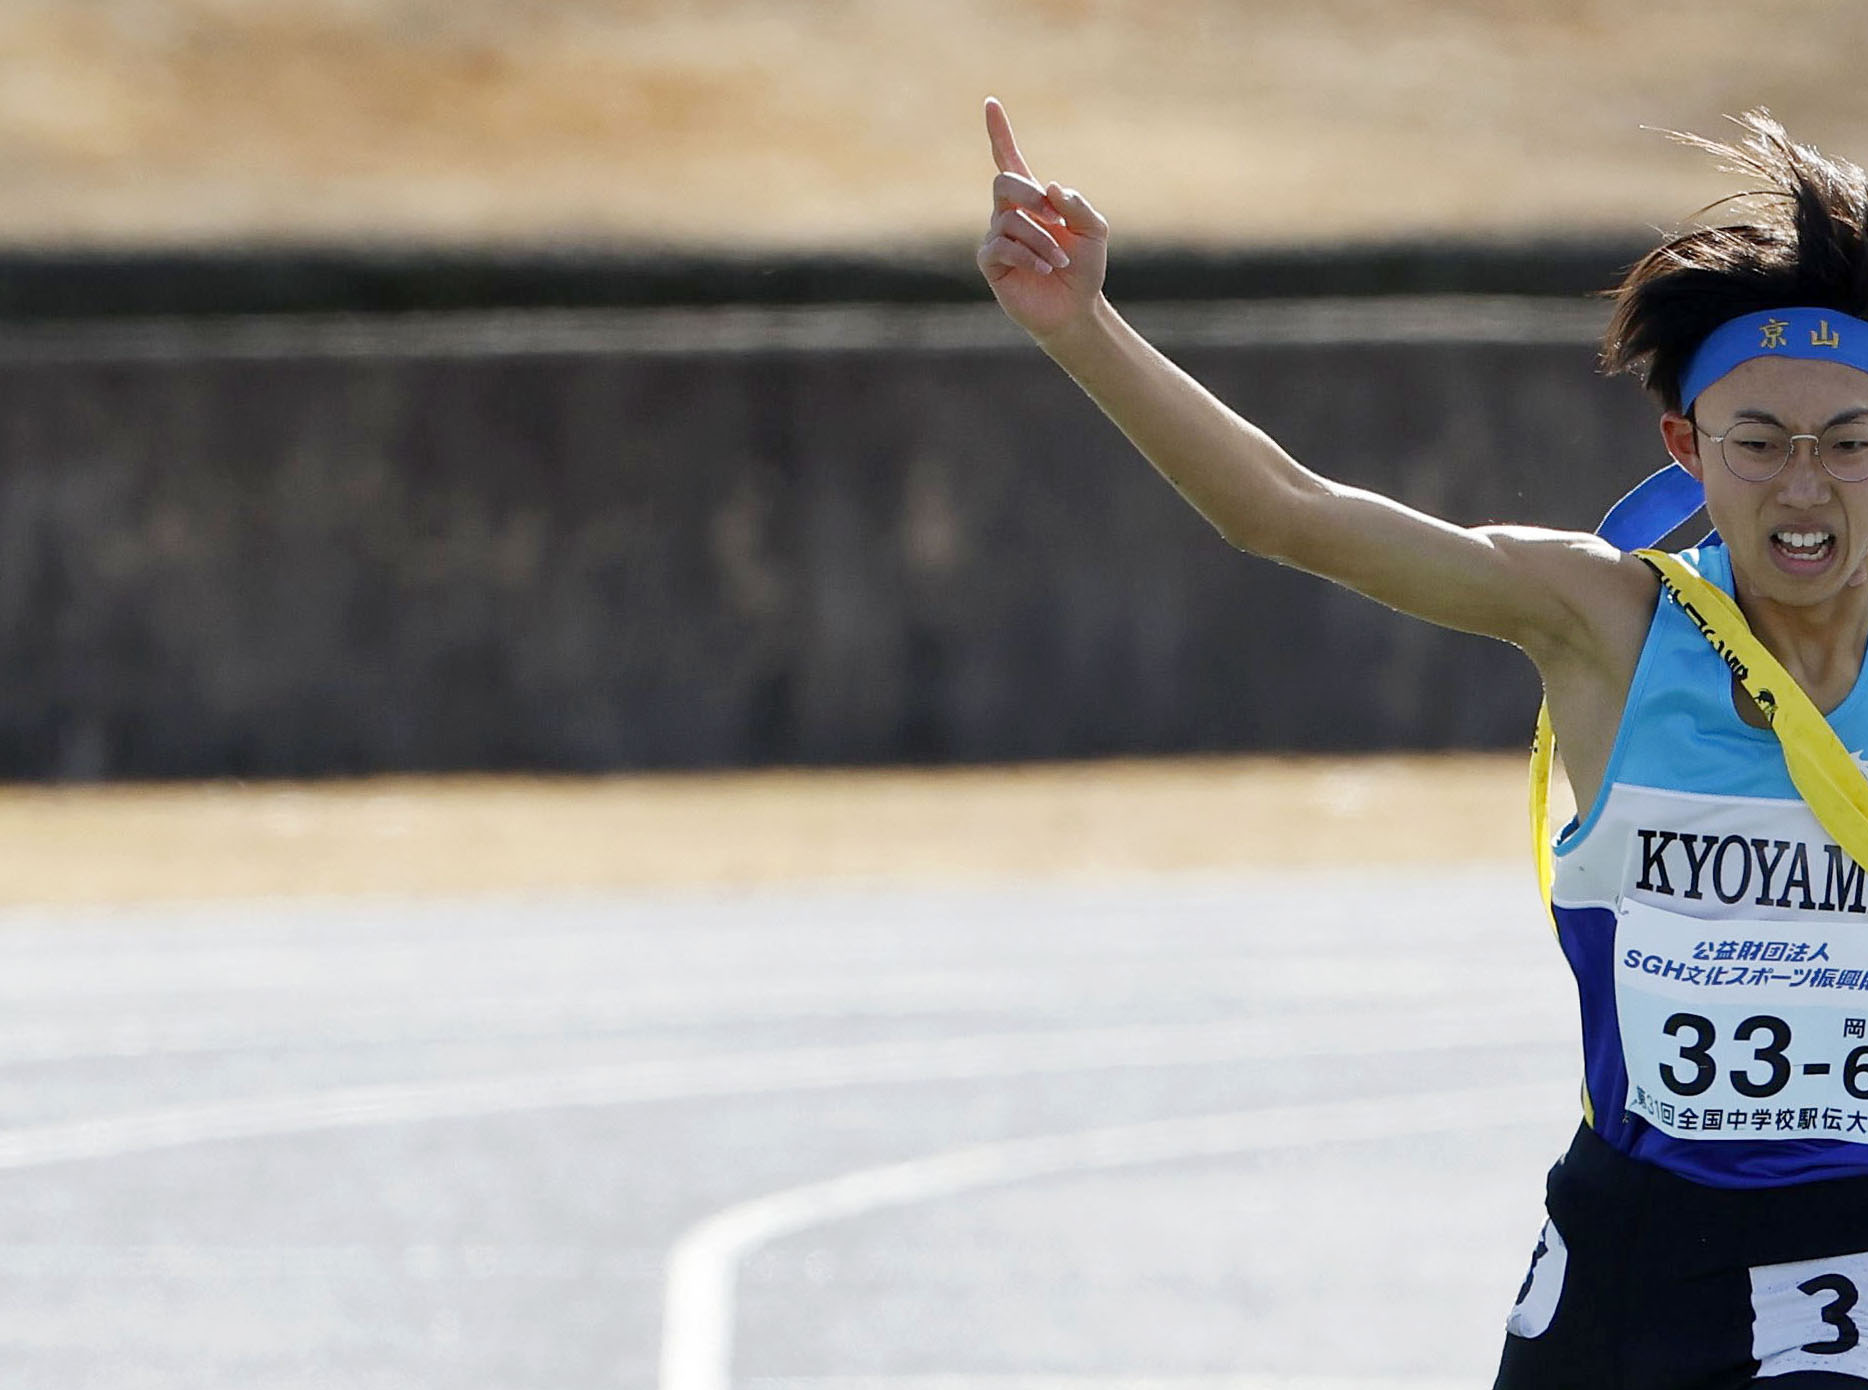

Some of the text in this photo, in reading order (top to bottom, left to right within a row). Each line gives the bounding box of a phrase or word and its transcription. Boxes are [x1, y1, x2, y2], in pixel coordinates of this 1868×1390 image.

[1759, 318, 1840, 350] 京山
[1692, 940, 1831, 963] 公益財団法人
